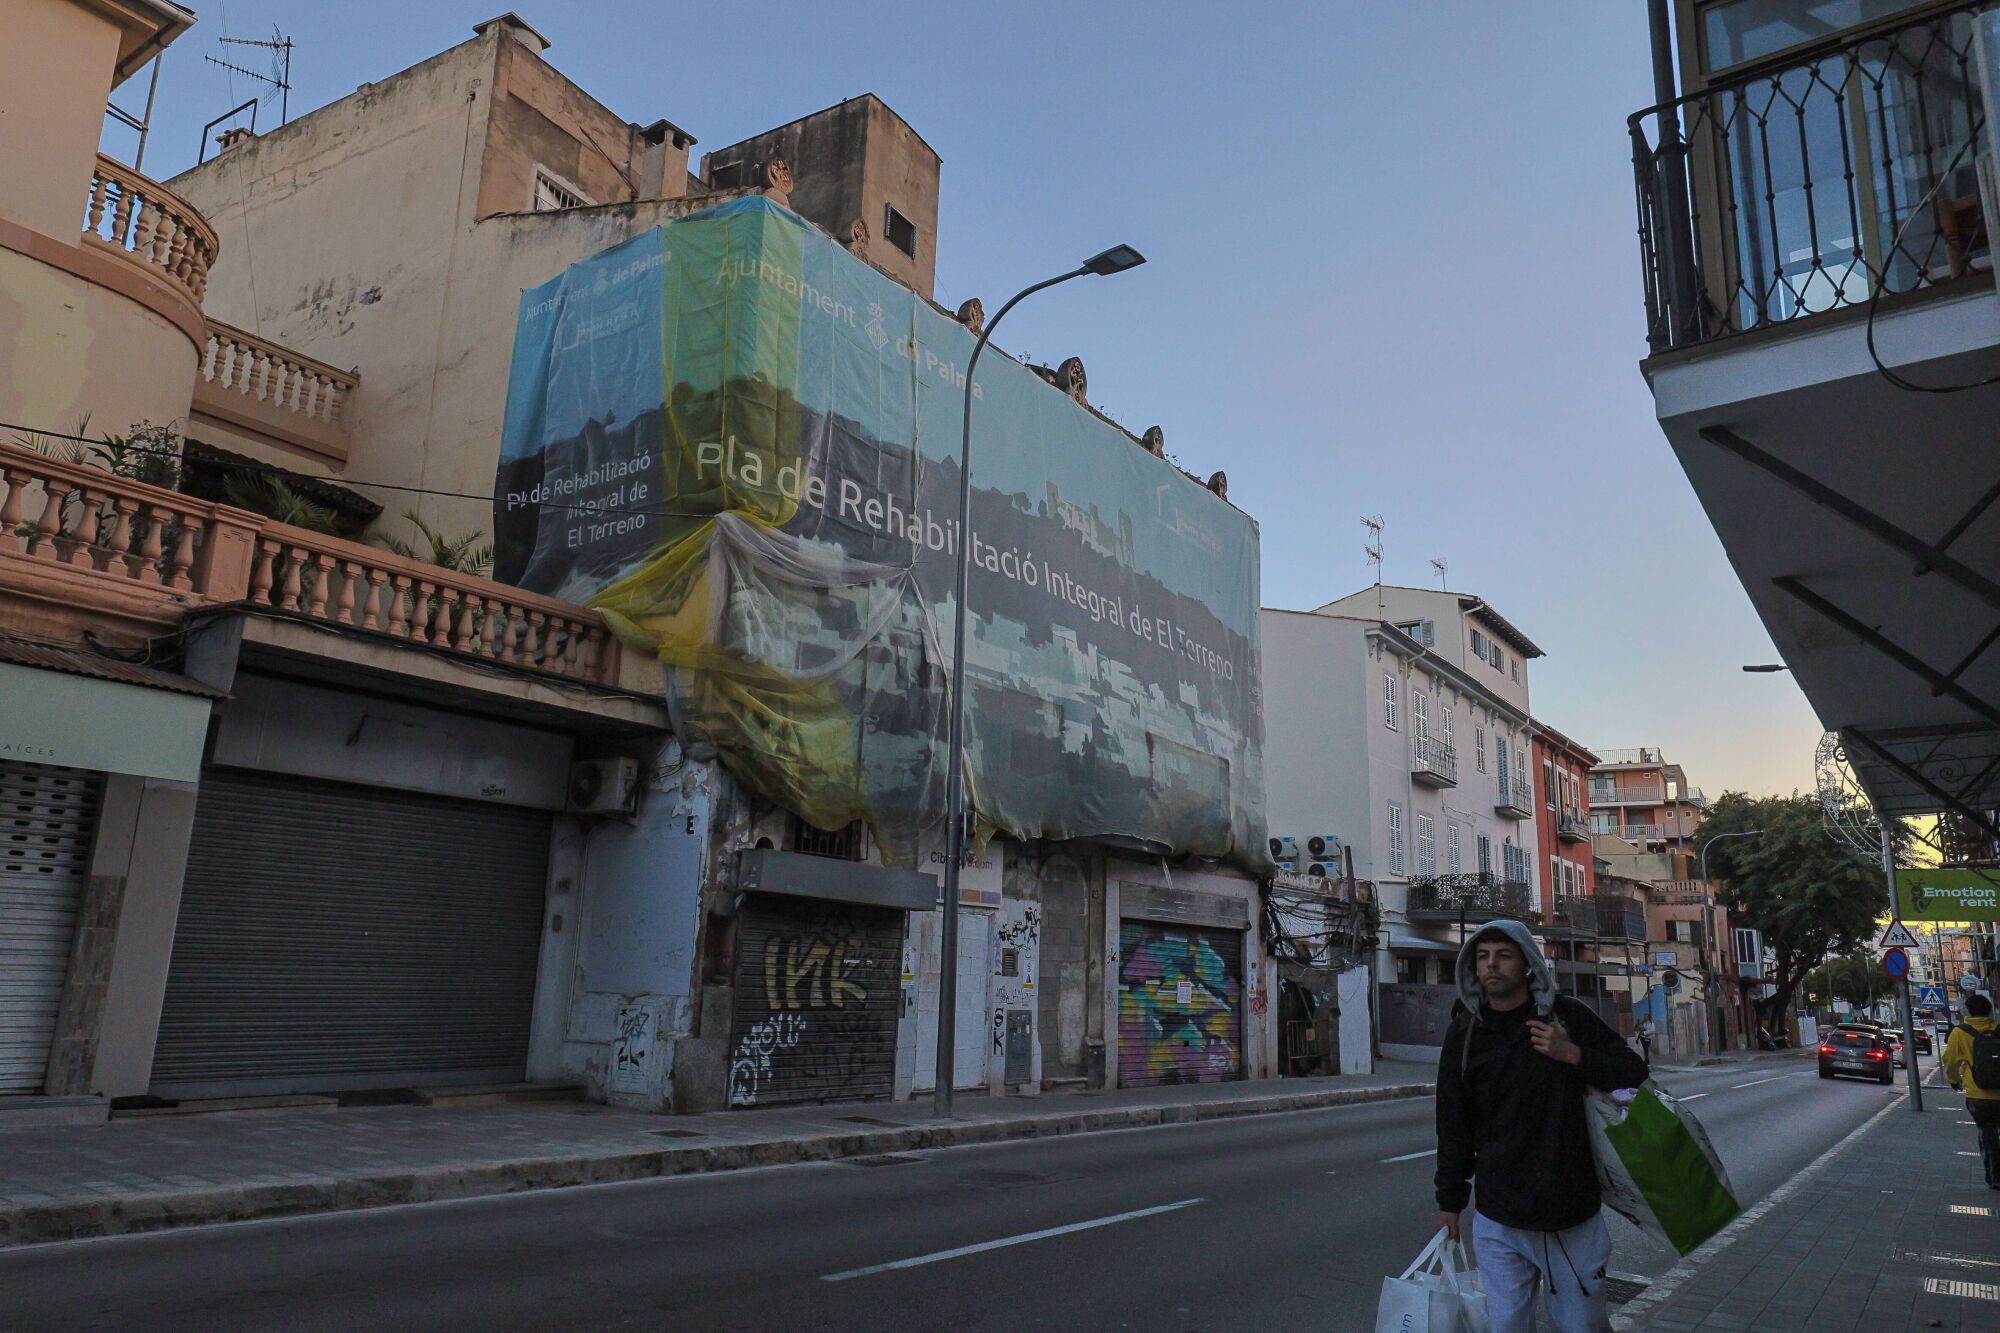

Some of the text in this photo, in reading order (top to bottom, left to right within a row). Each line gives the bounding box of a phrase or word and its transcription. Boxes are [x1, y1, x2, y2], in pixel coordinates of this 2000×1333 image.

[612, 267, 629, 285] de
[631, 250, 672, 277] Palma
[716, 256, 857, 328] Ajuntament
[530, 483, 550, 503] de
[554, 450, 650, 496] Rehabilitació
[630, 481, 647, 501] de
[568, 514, 645, 548] El Terreno
[697, 435, 1233, 680] Pla de Rehabilitació Integral de El Terreno
[1923, 887, 1995, 897] Emotion
[1960, 898, 1996, 907] rent
